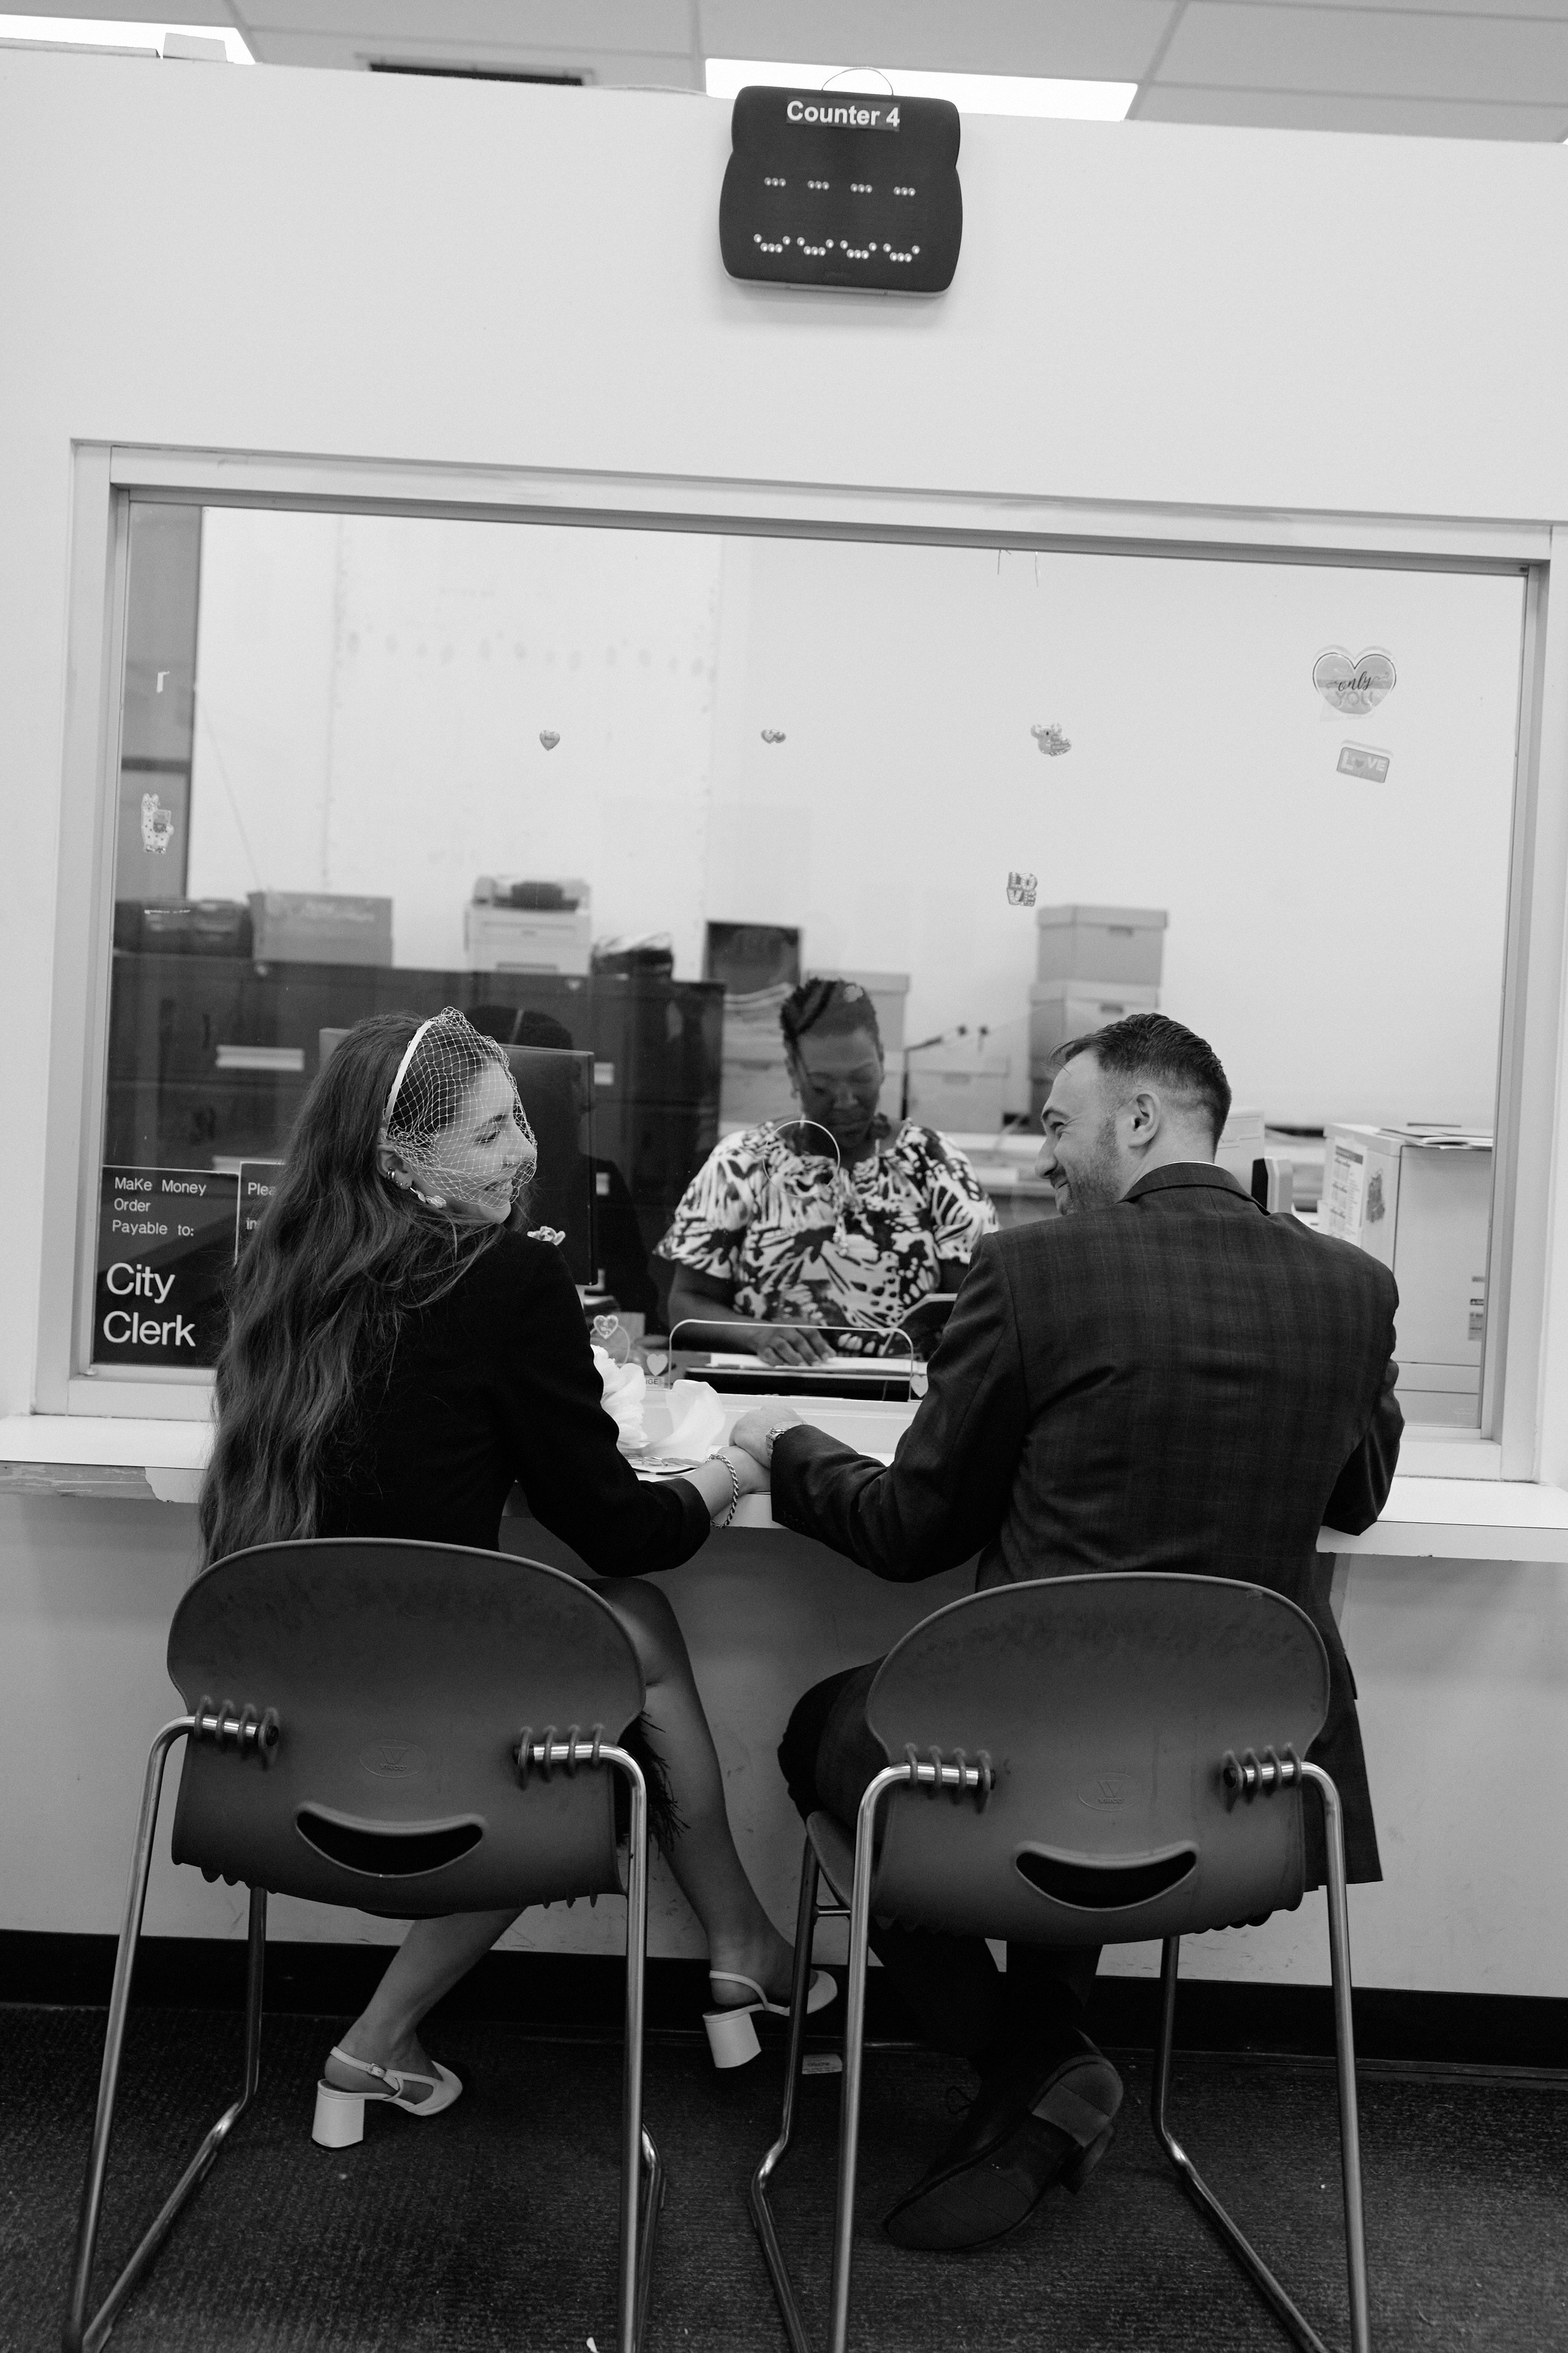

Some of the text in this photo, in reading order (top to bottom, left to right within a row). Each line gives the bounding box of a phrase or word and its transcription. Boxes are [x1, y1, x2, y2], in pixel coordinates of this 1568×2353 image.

[786, 100, 900, 127] Counter 4
[1338, 671, 1371, 691] only
[162, 1179, 206, 1196] Money
[114, 1198, 151, 1212] Order
[112, 1220, 194, 1236] Payable to:
[106, 1262, 176, 1304] City
[103, 1310, 196, 1347] Clerk
